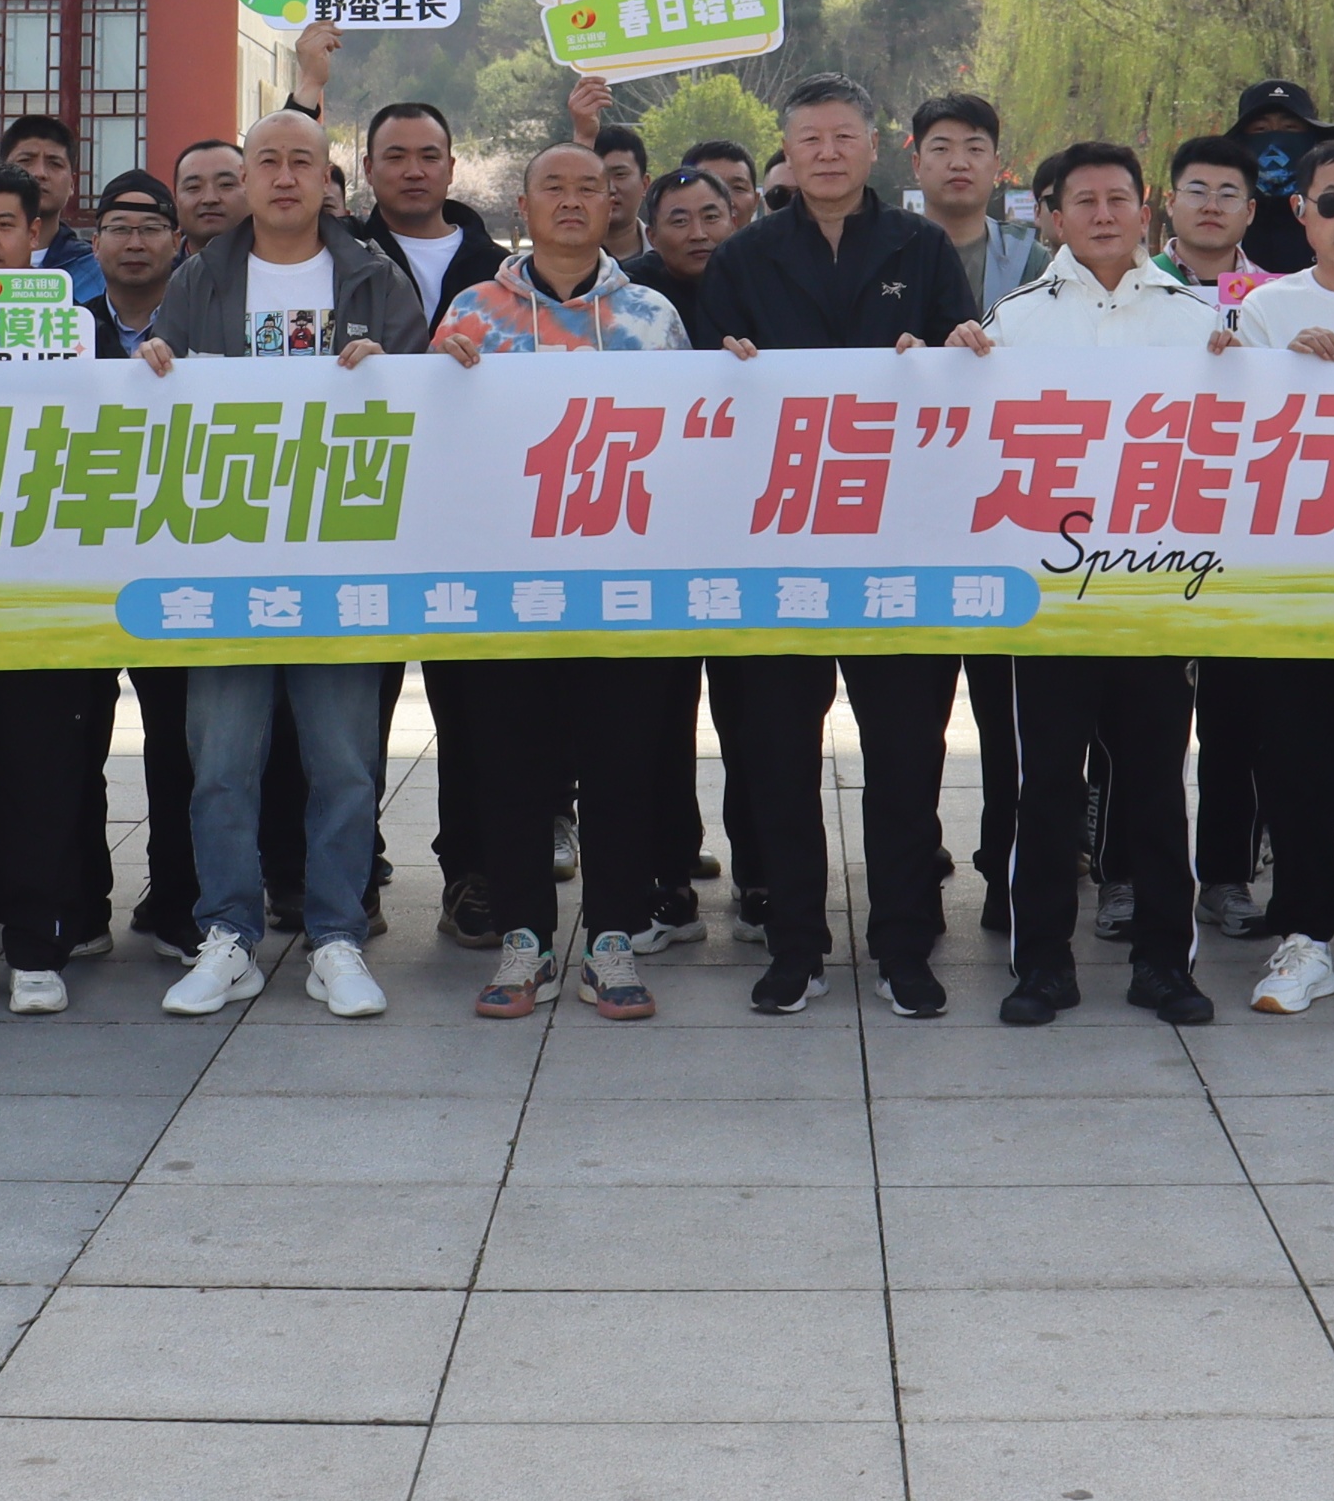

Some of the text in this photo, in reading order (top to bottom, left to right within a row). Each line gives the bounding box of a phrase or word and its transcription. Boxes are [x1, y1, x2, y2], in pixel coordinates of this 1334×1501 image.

[1041, 510, 1224, 601] Spring.
[160, 573, 1006, 630] 金达钼业春日轻盈活动
